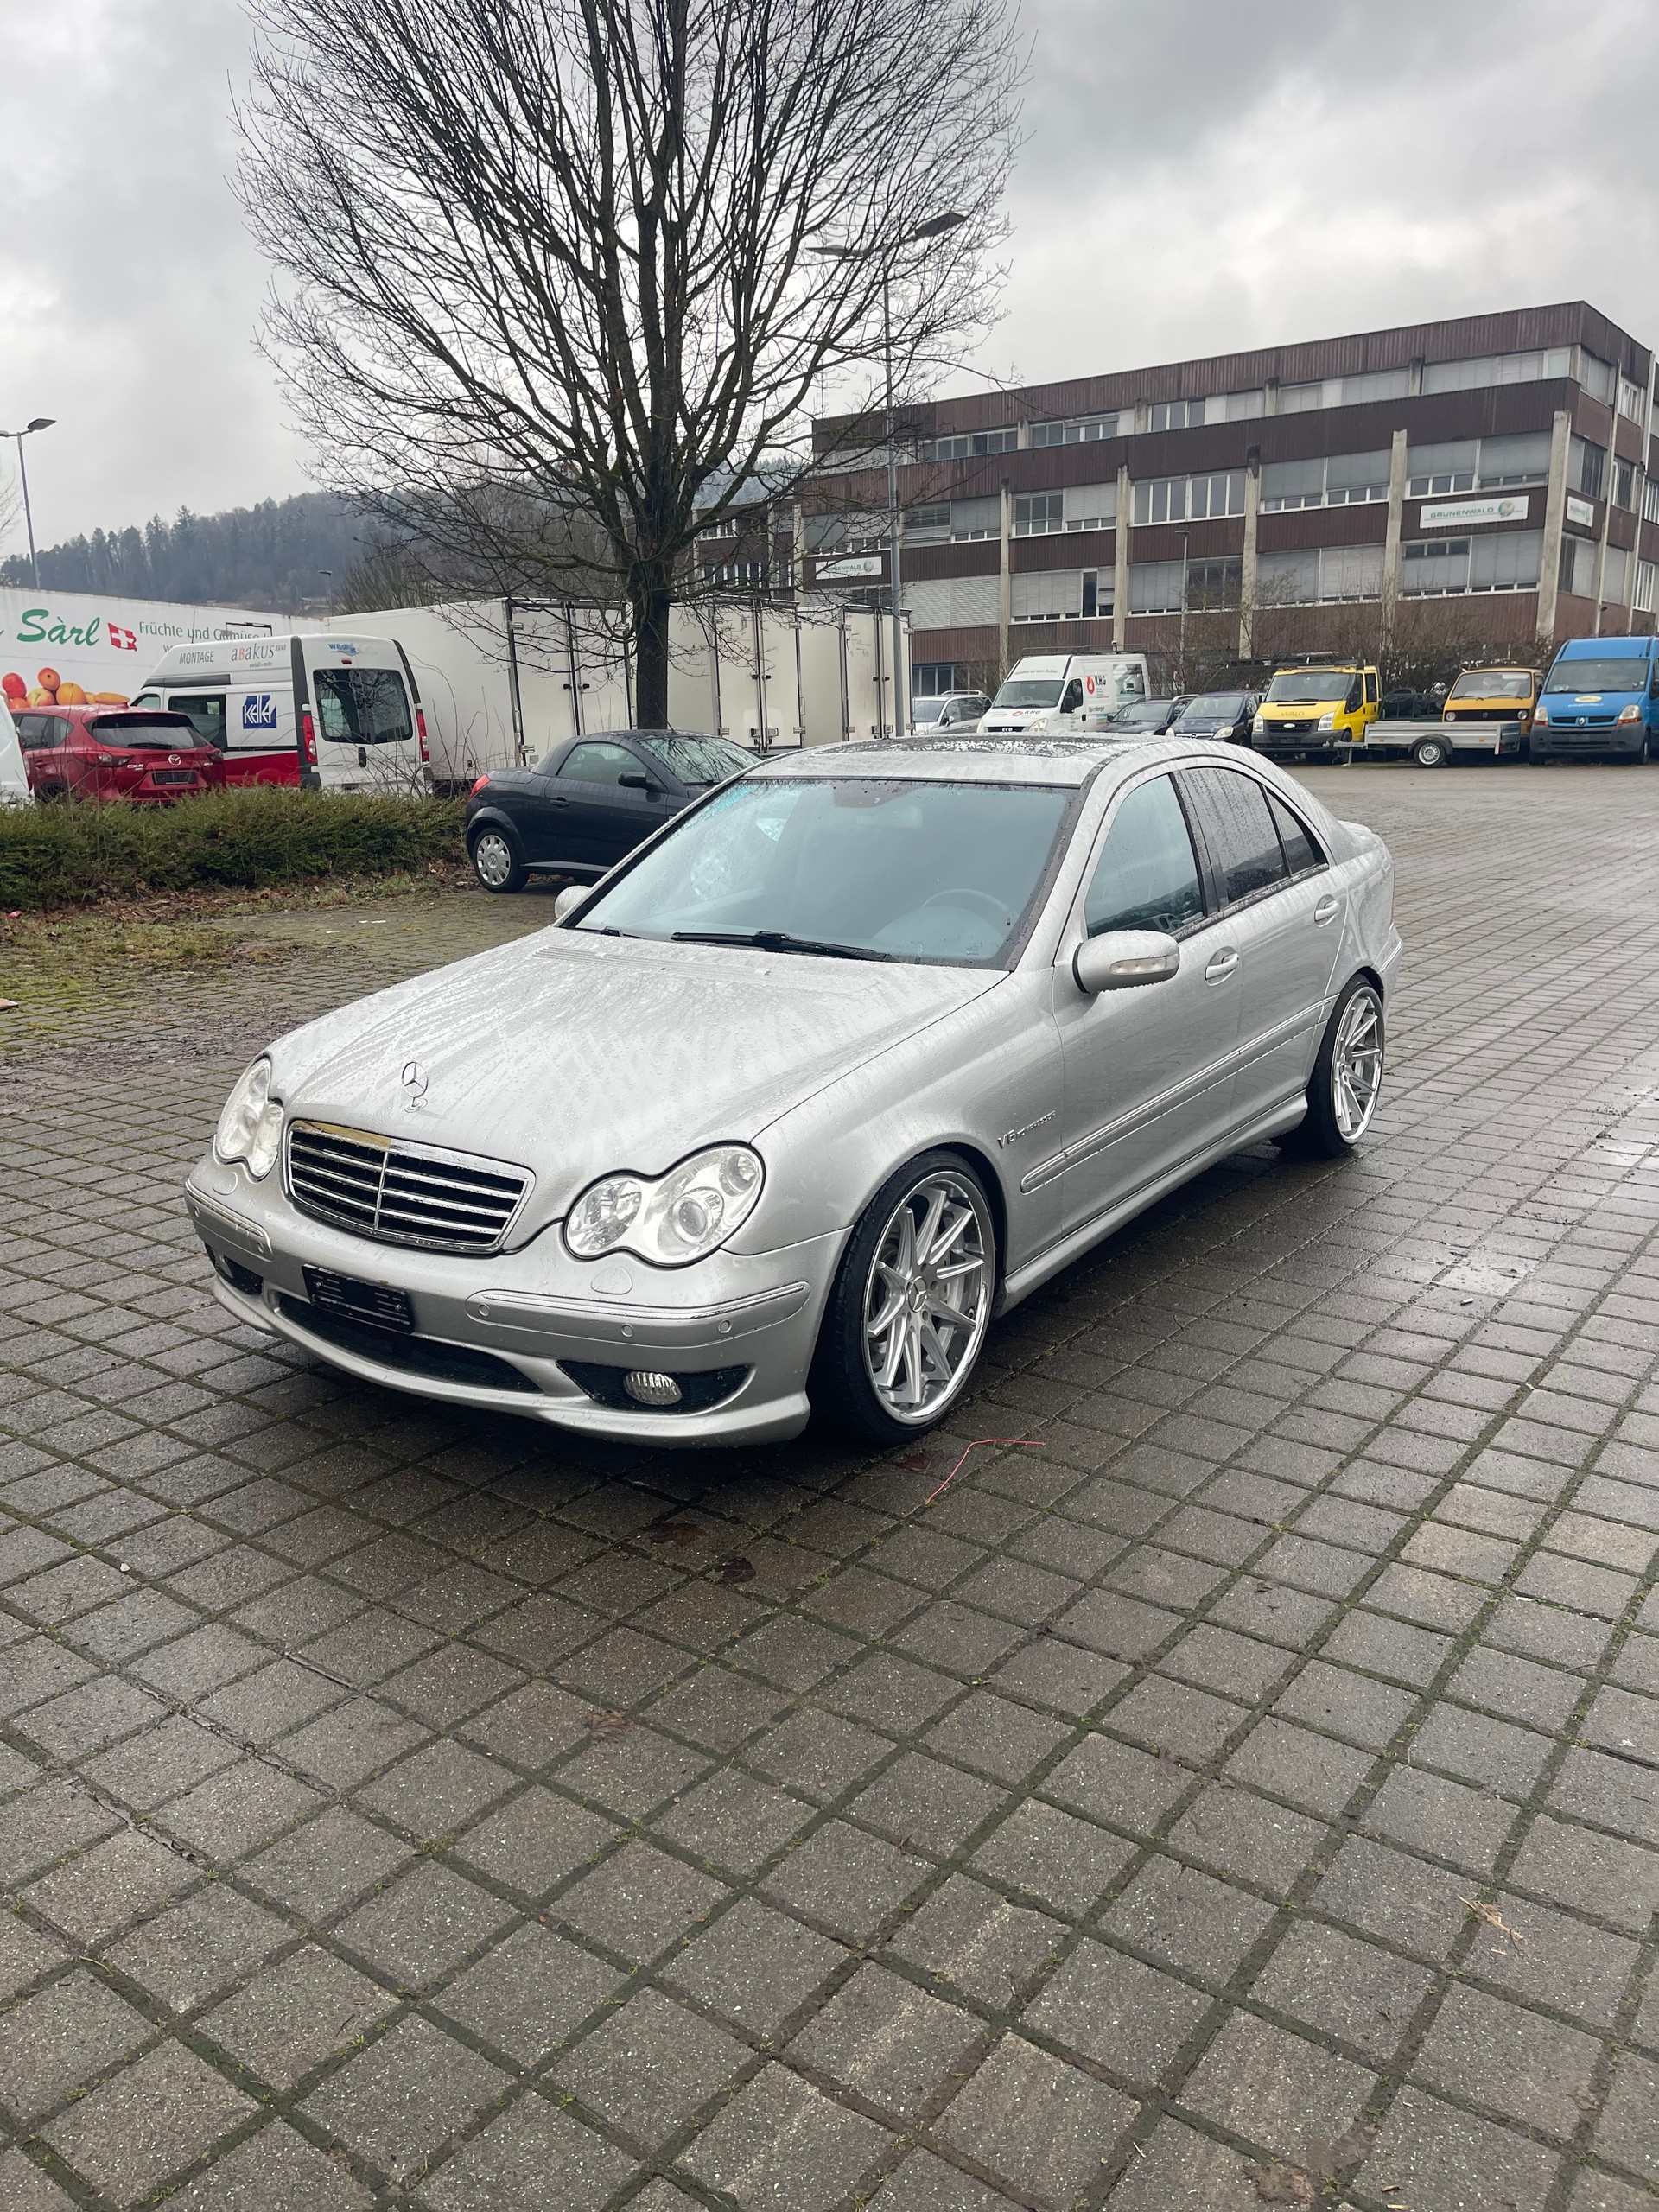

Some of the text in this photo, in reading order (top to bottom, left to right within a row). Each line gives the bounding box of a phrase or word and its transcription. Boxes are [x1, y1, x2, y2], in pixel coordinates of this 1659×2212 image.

[16, 608, 100, 646] Sàrl
[139, 621, 183, 637] Früchte
[188, 626, 210, 639] und
[179, 651, 214, 664] MONTAGE
[1095, 675, 1107, 686] KHG
[996, 1129, 1015, 1149] V6
